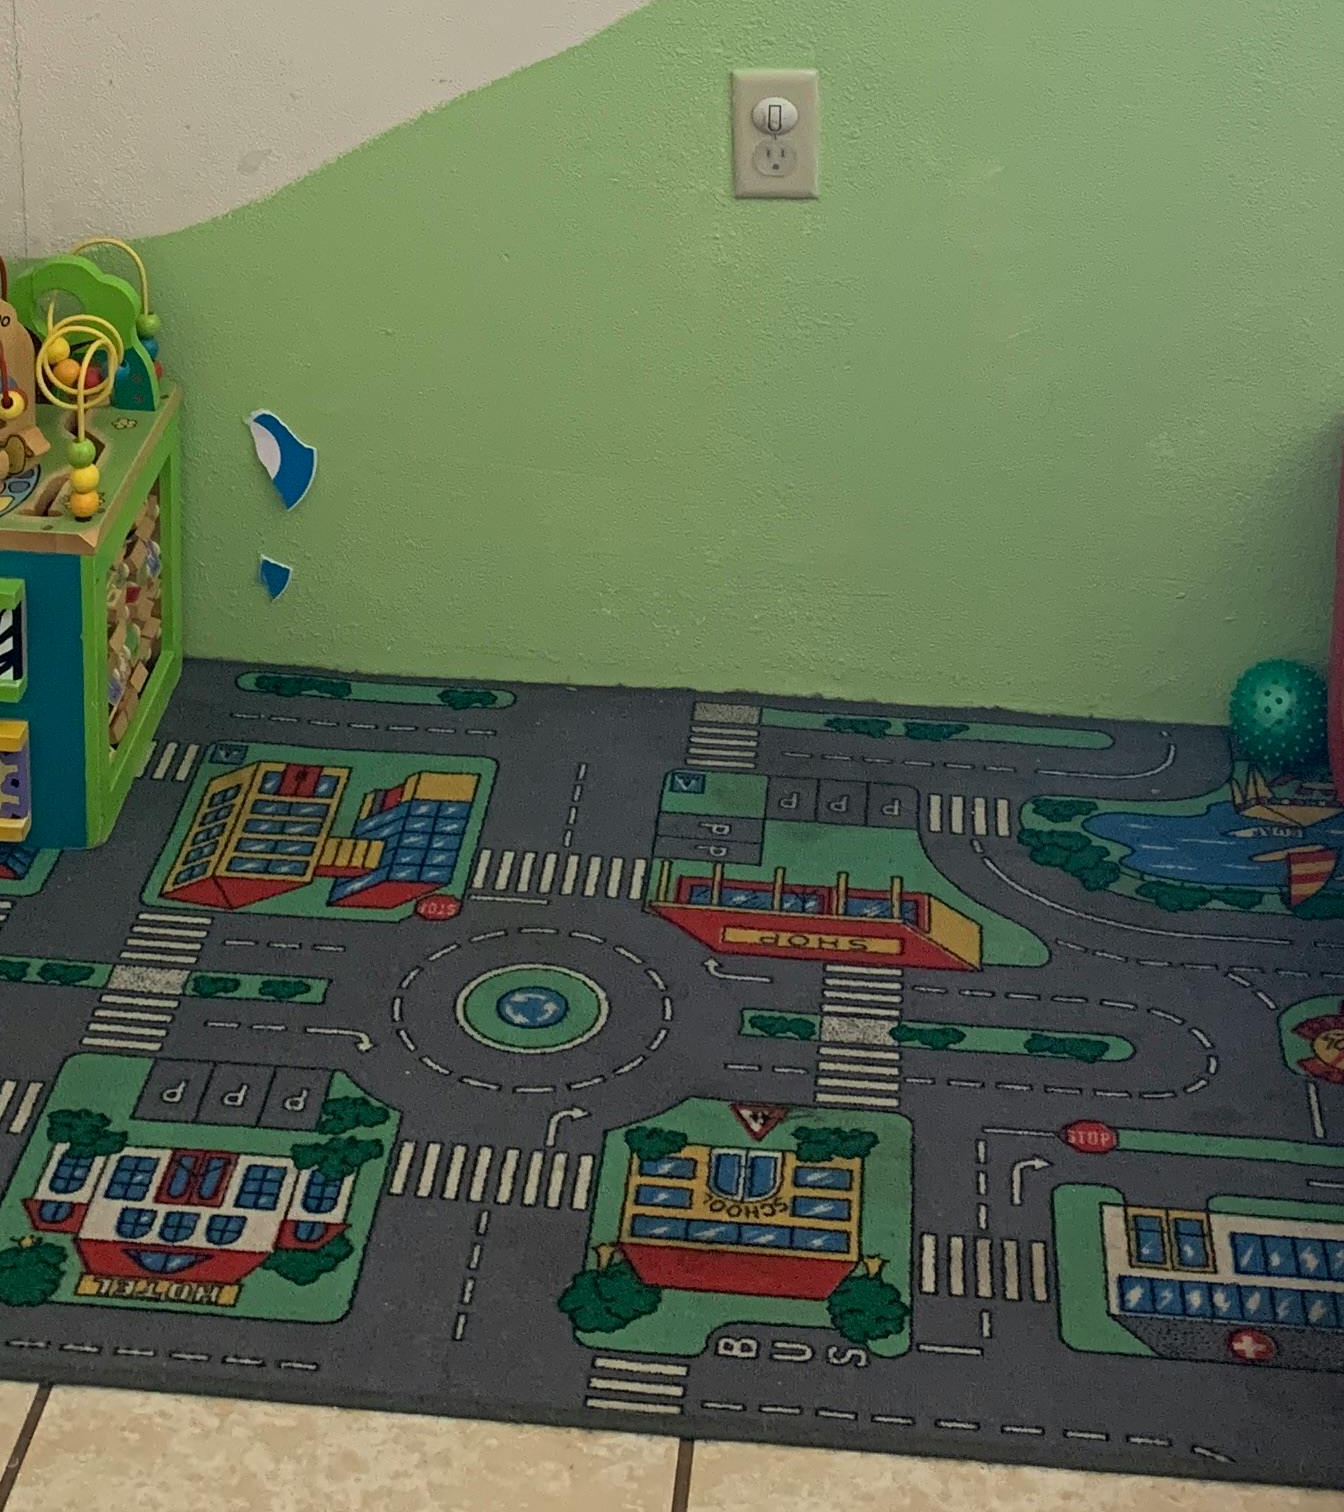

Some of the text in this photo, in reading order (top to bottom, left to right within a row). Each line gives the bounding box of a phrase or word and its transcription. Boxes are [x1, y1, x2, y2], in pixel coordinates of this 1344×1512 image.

[418, 901, 458, 914] STOP
[756, 931, 871, 954] SHOP
[1065, 1125, 1112, 1147] STOP
[702, 1191, 792, 1222] SCHOOL
[92, 1277, 226, 1305] HOTEL
[716, 1334, 869, 1368] BUS
